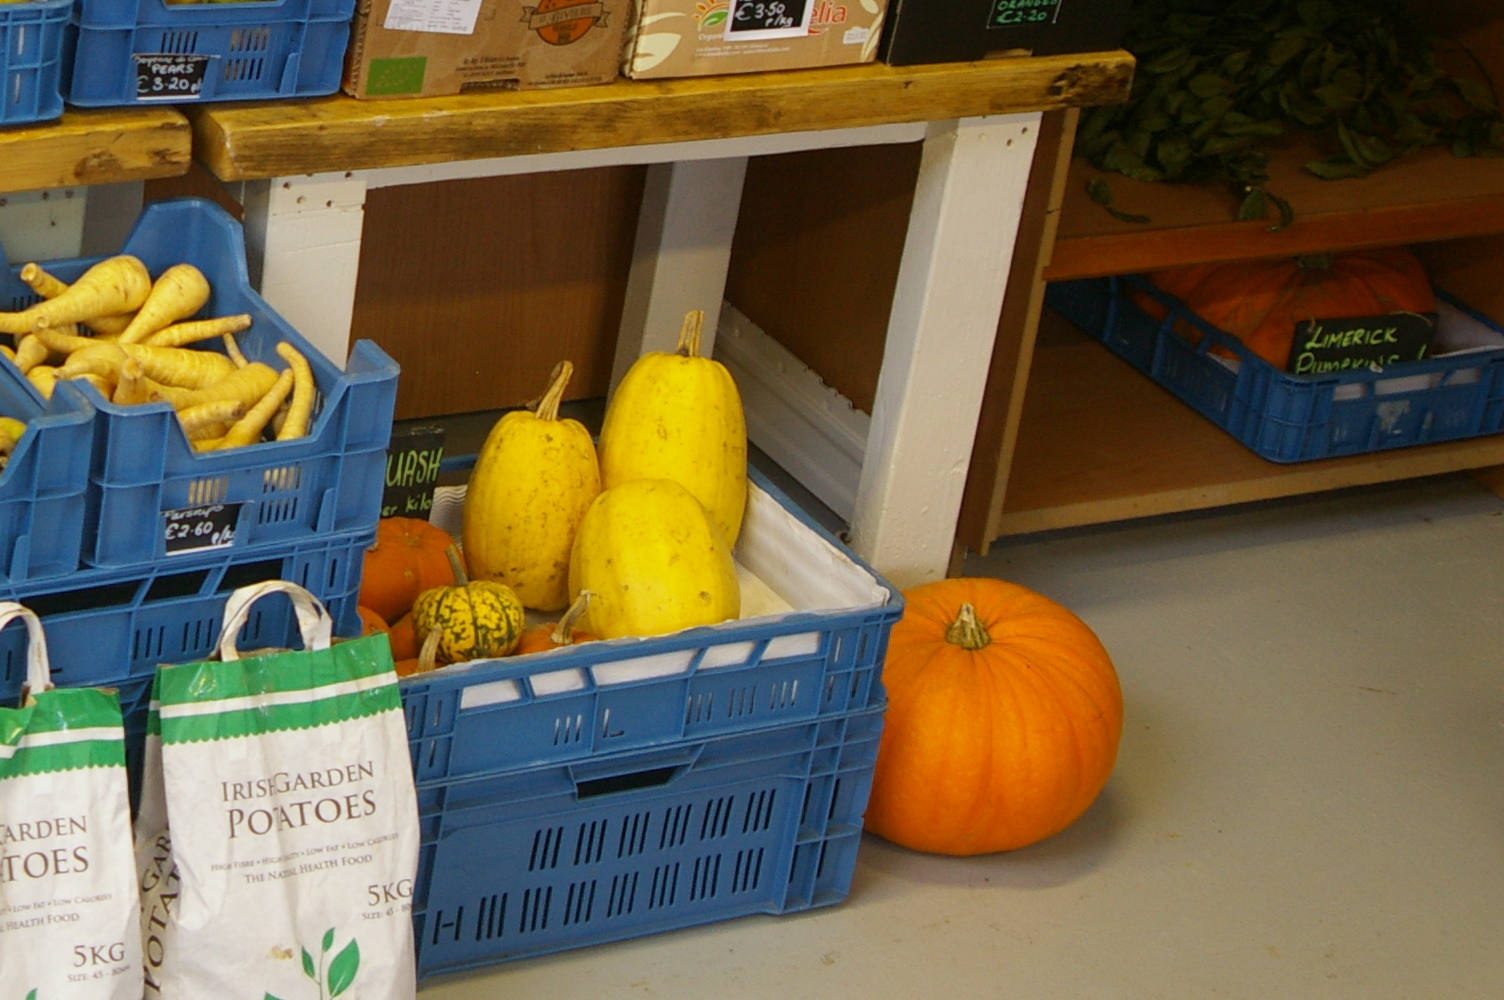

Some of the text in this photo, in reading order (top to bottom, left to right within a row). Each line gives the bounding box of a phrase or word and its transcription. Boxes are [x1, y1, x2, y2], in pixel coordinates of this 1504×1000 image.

[151, 63, 194, 75] PEARS
[1305, 326, 1398, 350] LIMERICK
[273, 760, 374, 794] GARDEN
[299, 860, 338, 874] HEALTH
[341, 854, 372, 866] FOOD
[367, 878, 413, 907] 5KG
[5, 917, 45, 932] HEALTH
[47, 912, 80, 924] FOOD
[73, 942, 125, 968] 5KG
